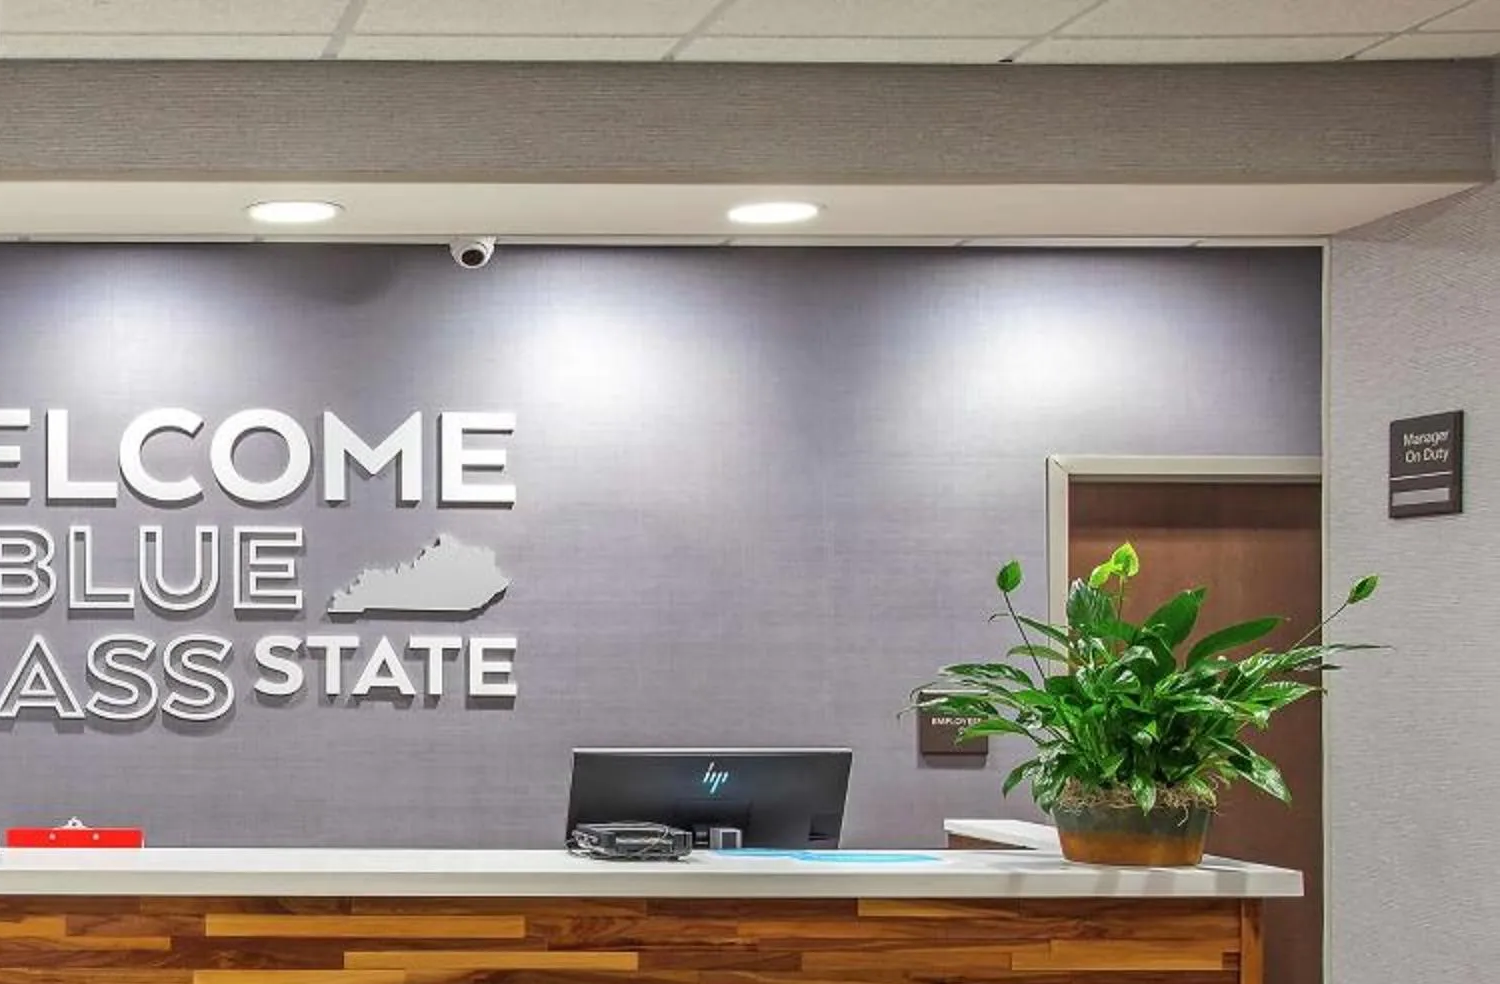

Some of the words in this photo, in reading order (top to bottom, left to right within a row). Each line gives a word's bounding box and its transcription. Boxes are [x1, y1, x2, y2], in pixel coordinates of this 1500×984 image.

[1403, 430, 1450, 447] Manager
[1405, 449, 1421, 463] On
[1423, 447, 1449, 462] Duty
[253, 635, 518, 698] STATE
[703, 761, 729, 794] hp
